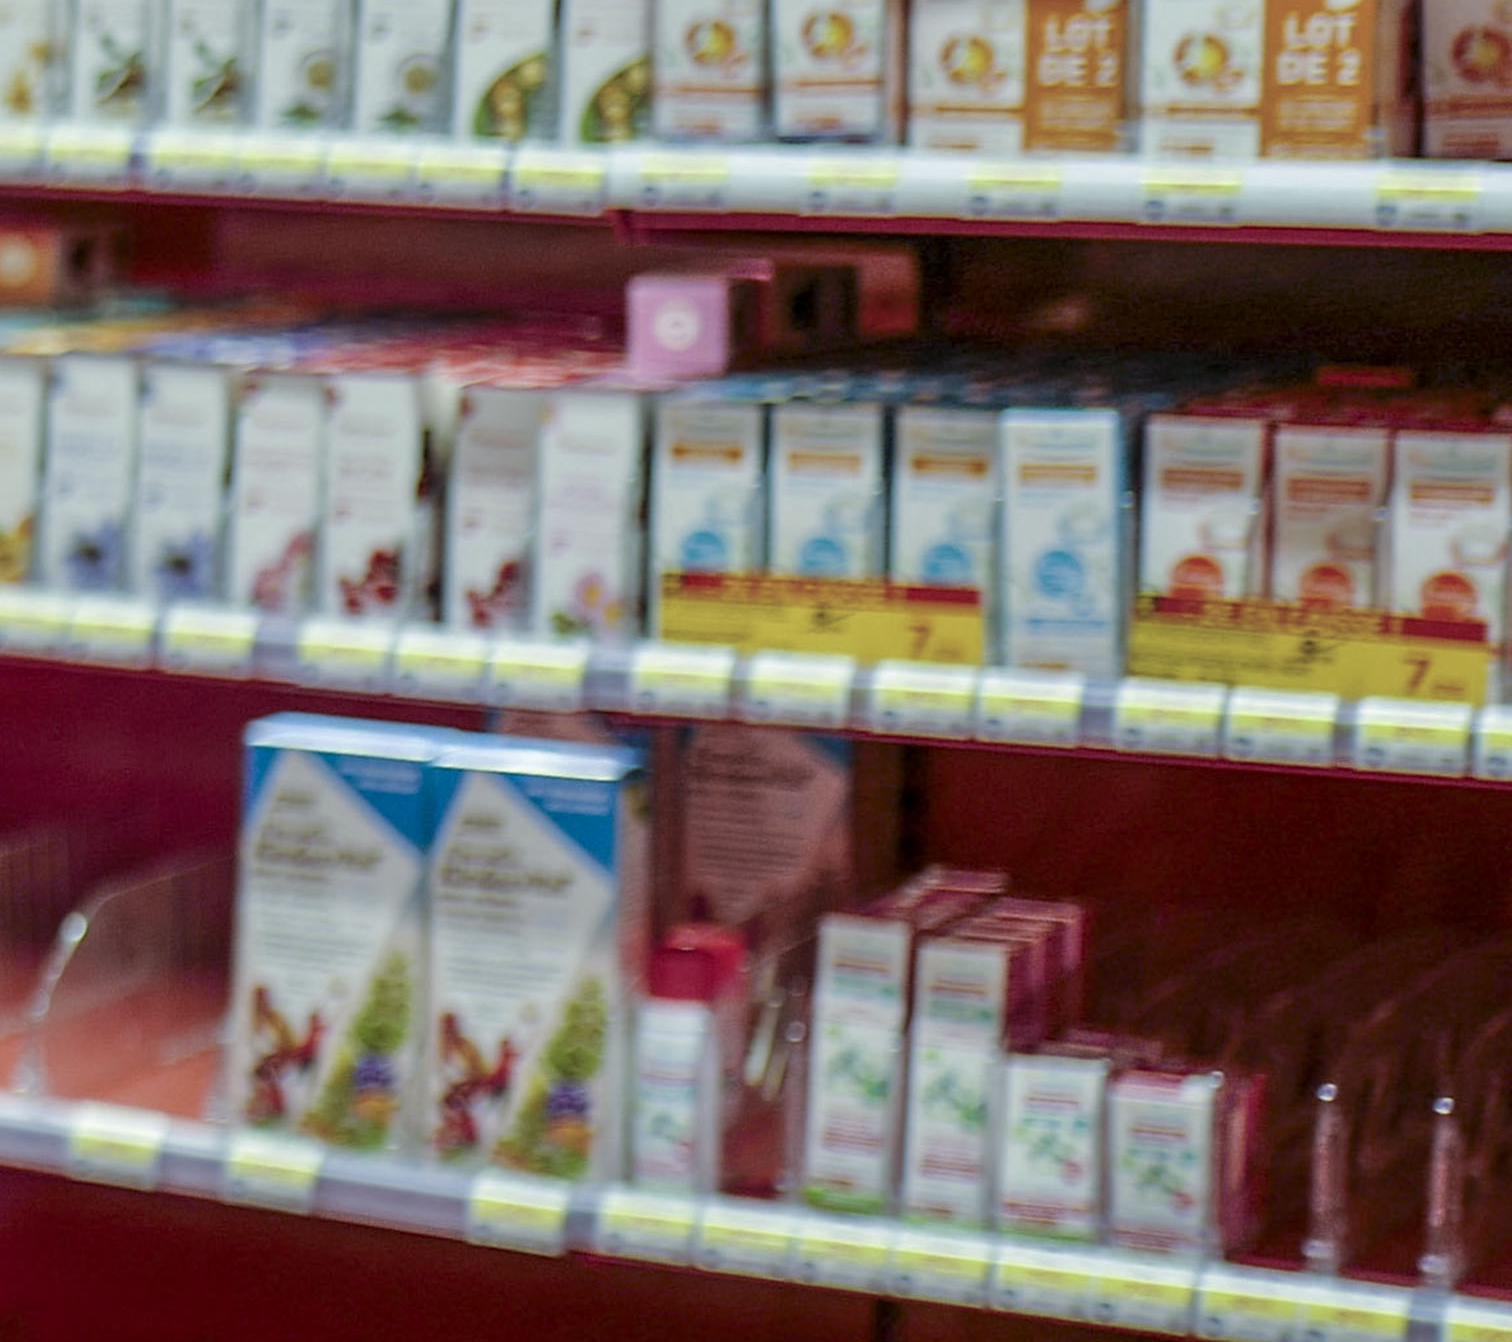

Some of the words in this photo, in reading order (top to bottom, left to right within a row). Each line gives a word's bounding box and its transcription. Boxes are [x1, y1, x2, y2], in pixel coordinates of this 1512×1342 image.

[1044, 11, 1115, 52] LOT
[1282, 9, 1359, 50] LOT
[1036, 50, 1087, 88] DE
[1094, 50, 1120, 88] 2
[1275, 48, 1328, 86] DE
[1335, 48, 1362, 86] 2
